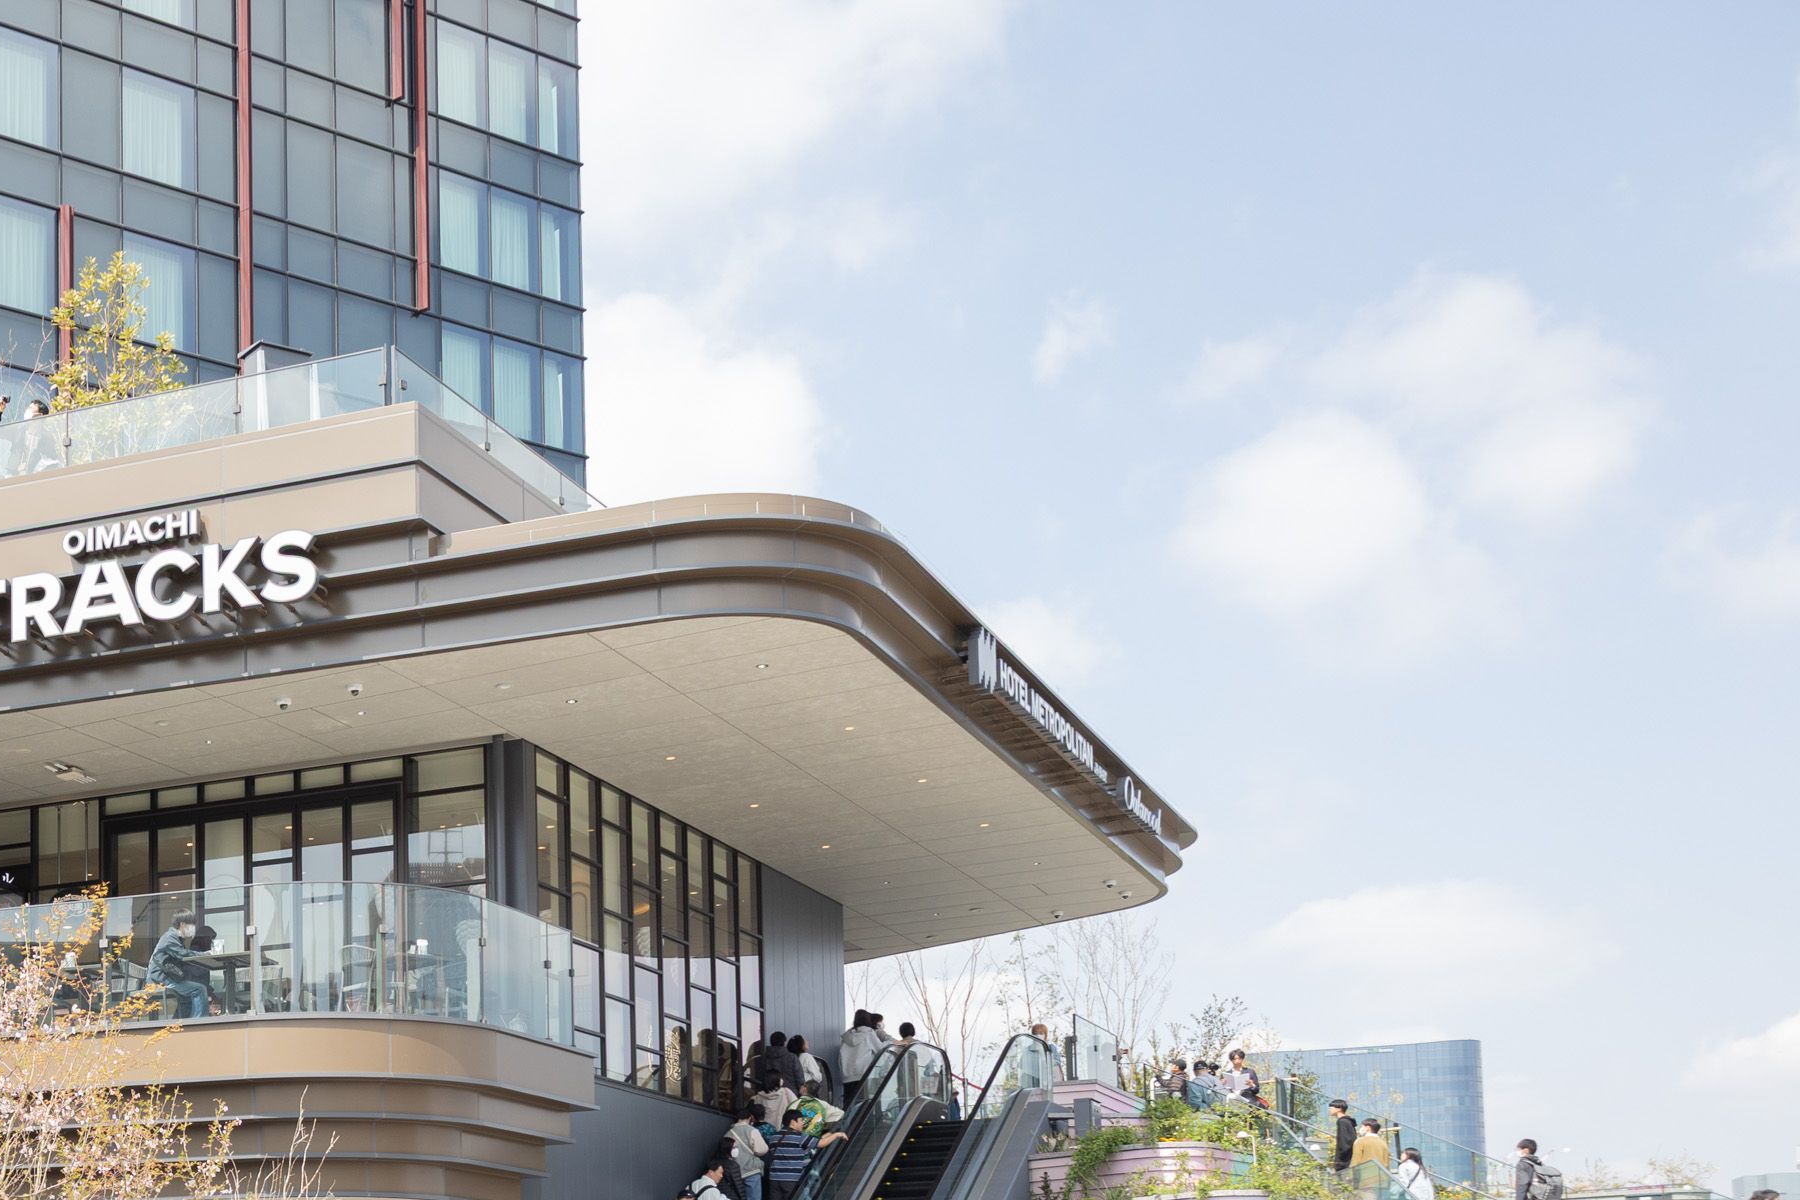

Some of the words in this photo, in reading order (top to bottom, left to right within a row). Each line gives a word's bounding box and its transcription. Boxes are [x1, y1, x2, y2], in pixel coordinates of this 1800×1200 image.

[62, 509, 201, 557] OIMACHI
[999, 658, 1031, 713] HOTEL
[1031, 688, 1094, 771] METROPOLITAN
